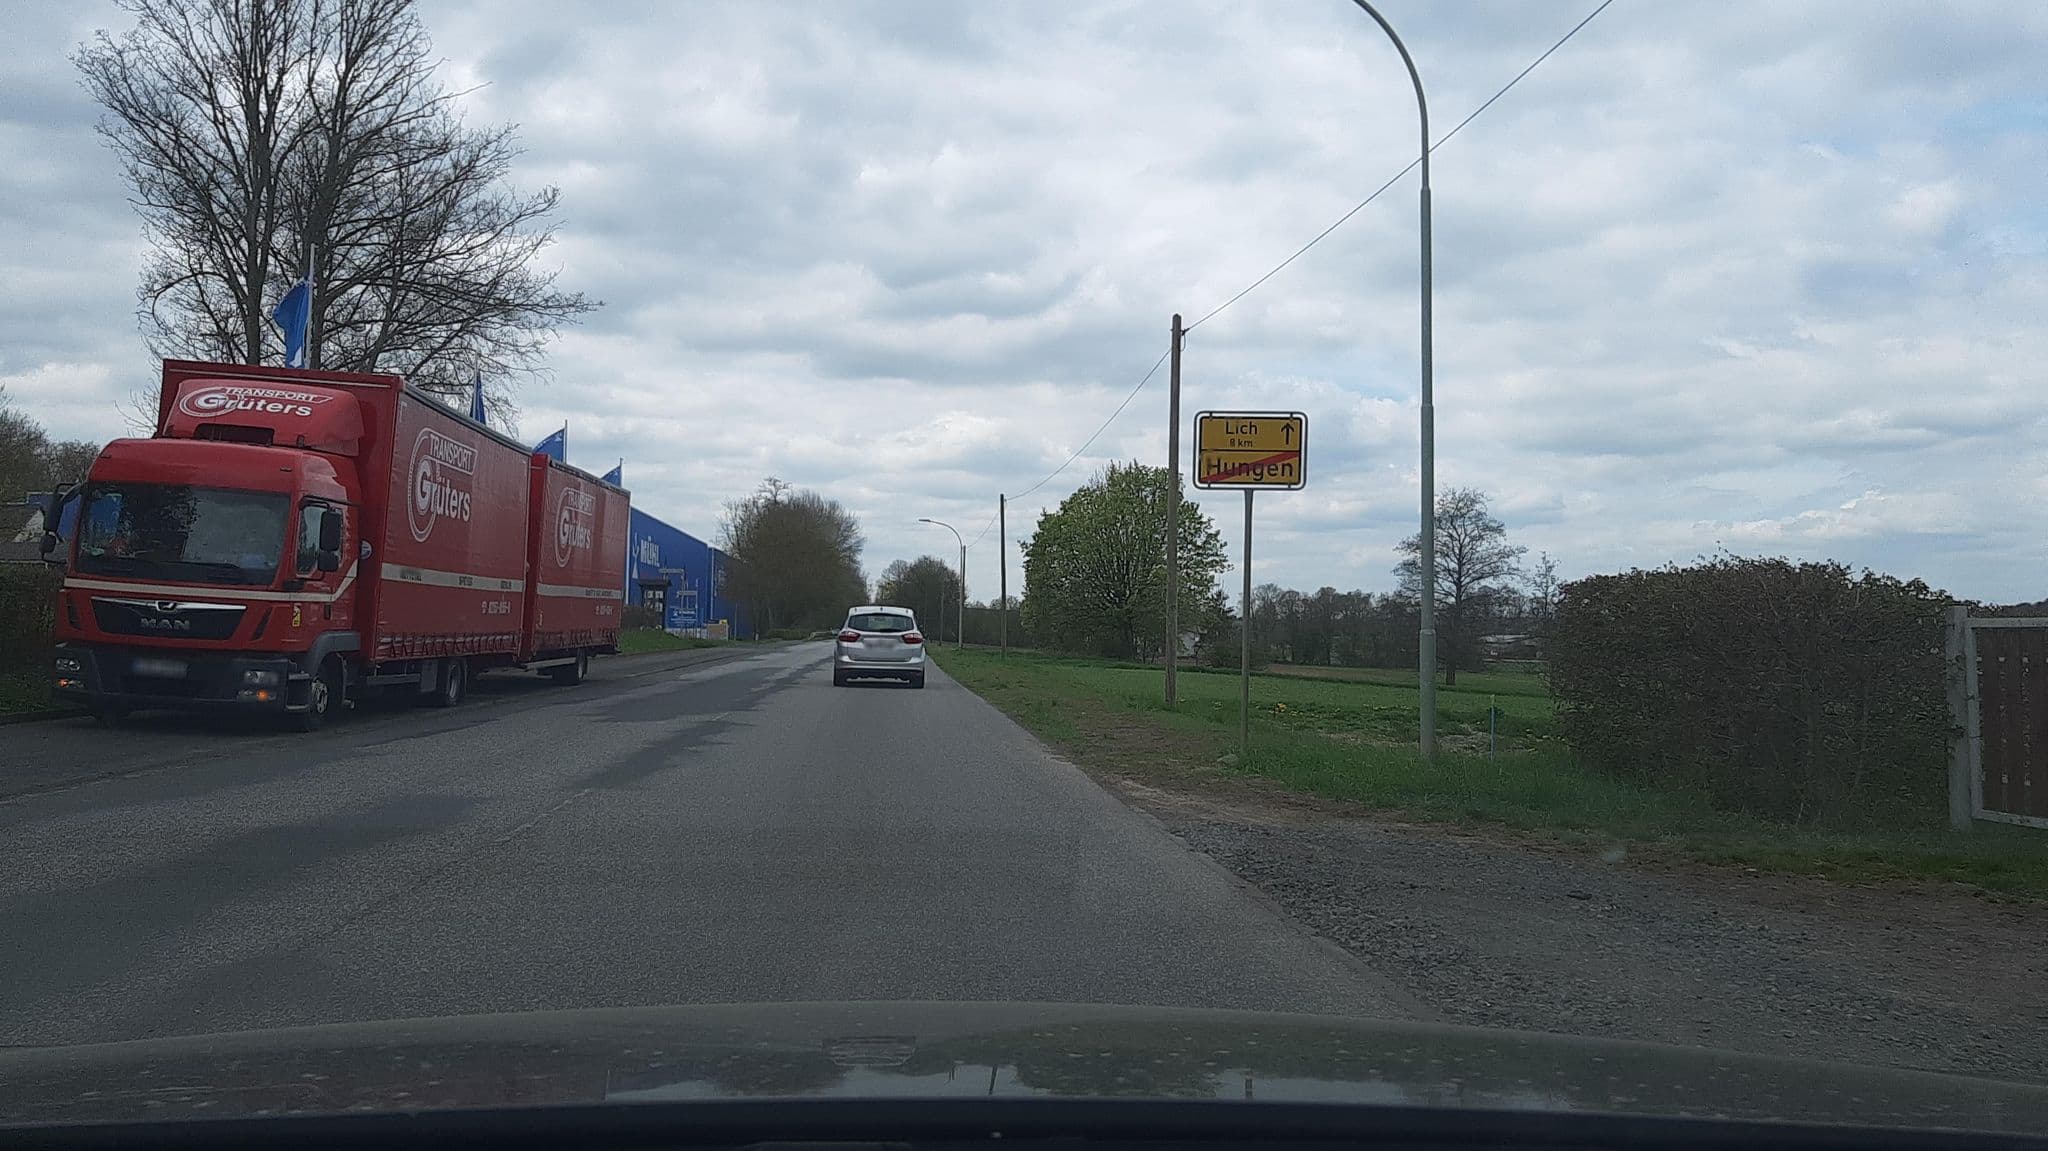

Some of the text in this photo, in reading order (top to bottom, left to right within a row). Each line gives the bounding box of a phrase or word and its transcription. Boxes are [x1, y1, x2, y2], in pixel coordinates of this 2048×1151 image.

[225, 386, 316, 402] TRANSPORT
[196, 393, 312, 417] Grüters
[1225, 421, 1258, 435] Lich
[430, 433, 473, 471] TRANSPORT
[1229, 439, 1253, 448] 8 km
[1206, 457, 1293, 481] Hungen
[416, 459, 471, 522] Grüters
[141, 617, 190, 631] MAN
